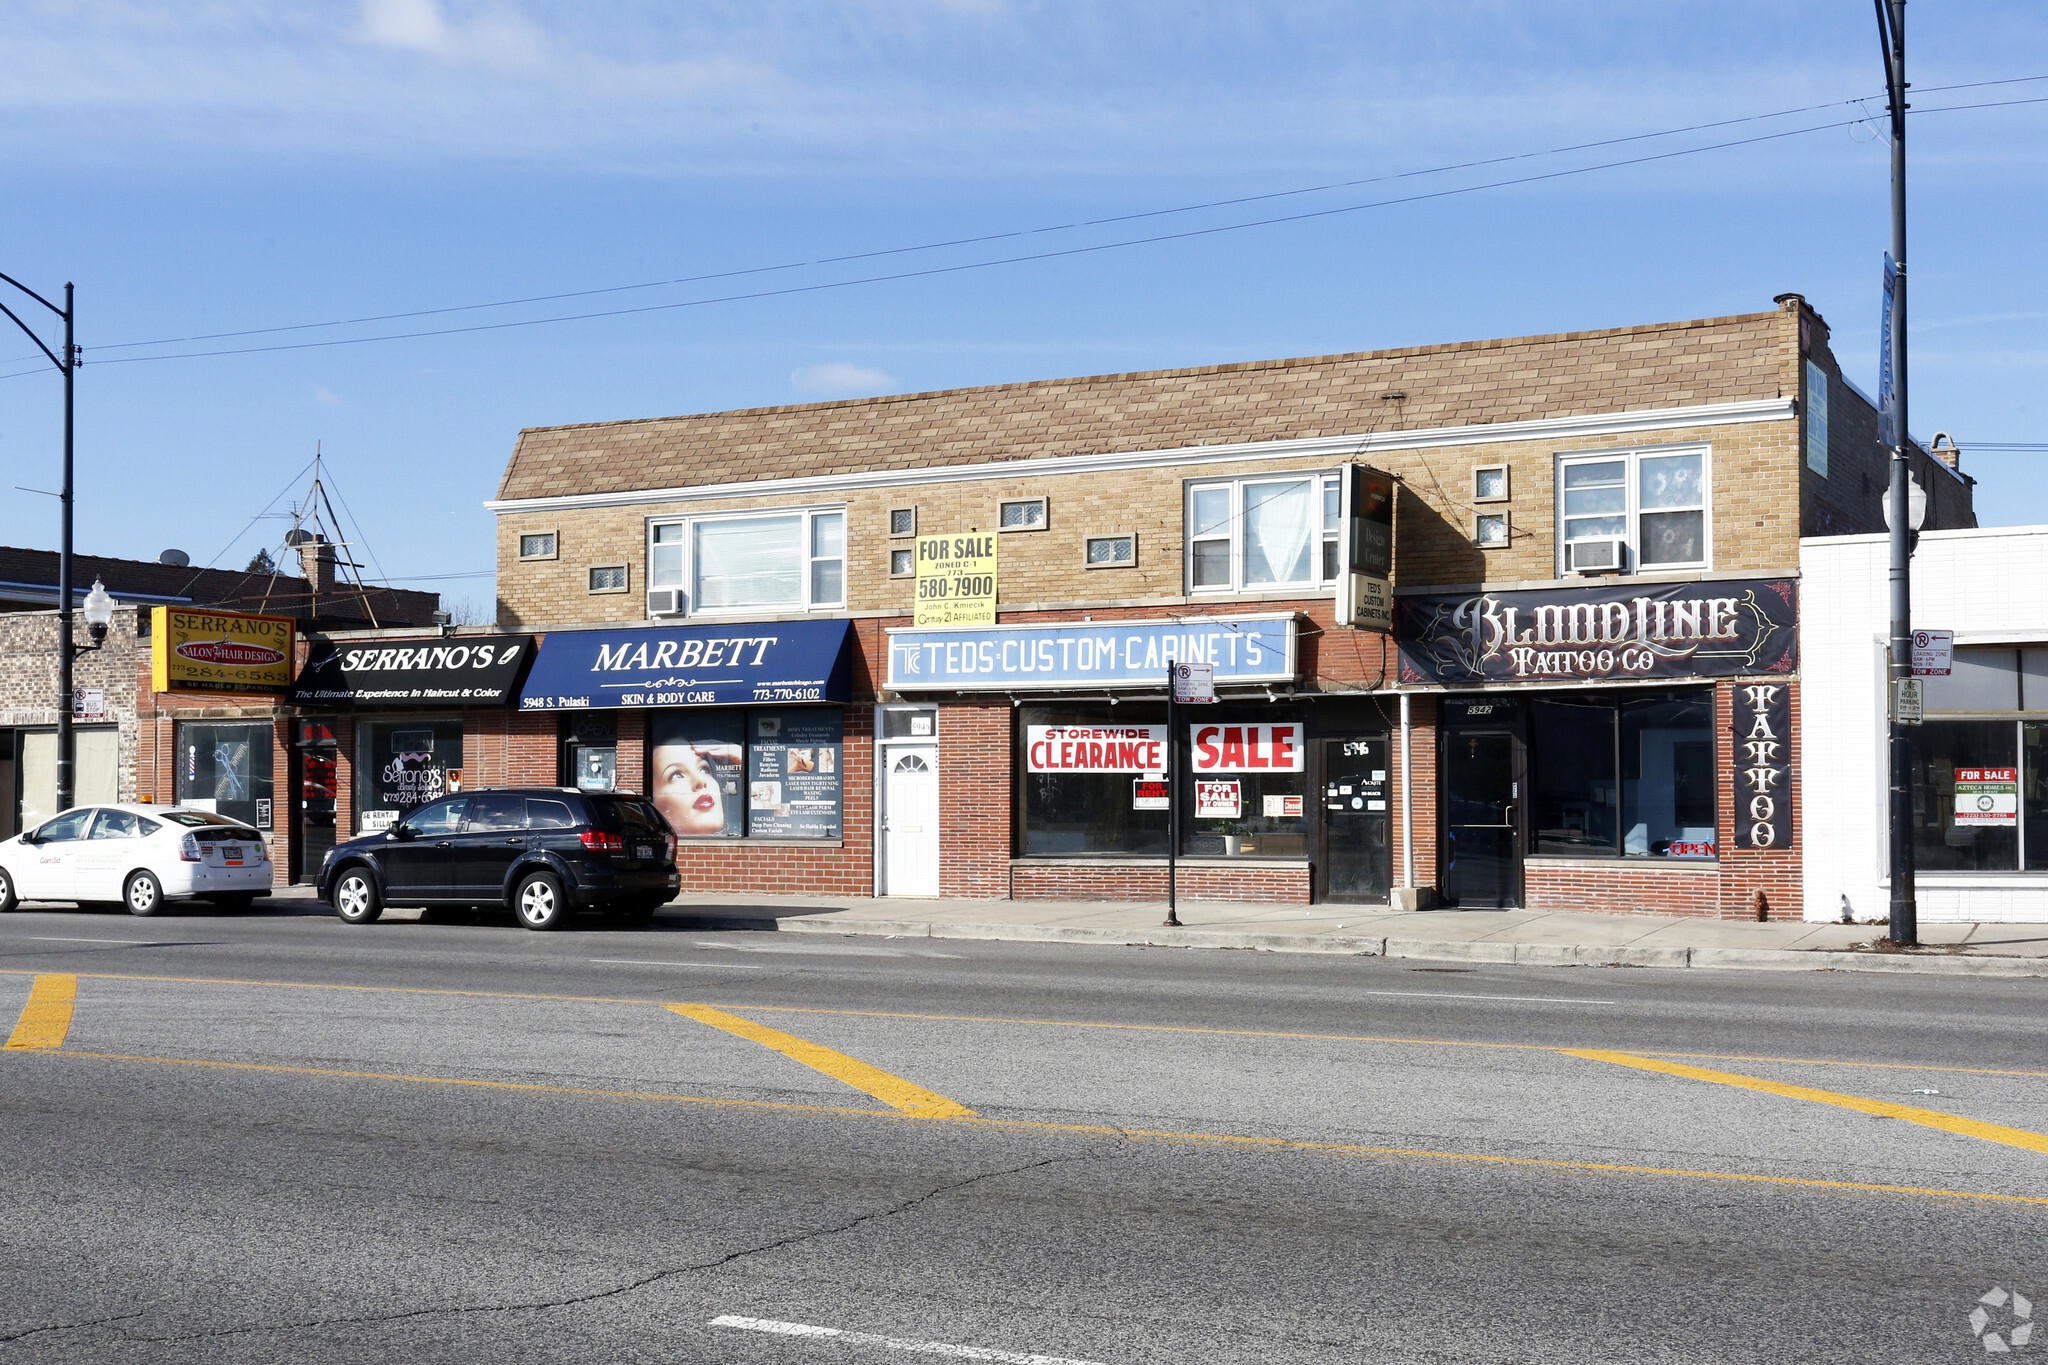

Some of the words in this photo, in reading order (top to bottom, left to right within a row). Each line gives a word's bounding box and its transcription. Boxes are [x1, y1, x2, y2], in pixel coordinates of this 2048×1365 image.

[1365, 527, 1385, 549] Design
[920, 540, 949, 560] FOR
[954, 537, 993, 558] SALE
[935, 561, 961, 569] ZONED
[1365, 550, 1385, 567] Center
[919, 576, 993, 598] 580-7900
[1367, 582, 1381, 594] TED'S
[944, 601, 952, 609] C.
[954, 600, 985, 609] Kmiecik
[1363, 594, 1384, 606] CUSTOM
[918, 613, 942, 625] Century
[943, 611, 952, 623] 21
[953, 611, 992, 622] AFFILIATED
[1357, 606, 1381, 619] CABINETS
[1381, 609, 1391, 620] INC.
[174, 614, 288, 637] SERRANO'S
[182, 646, 213, 657] SALON
[221, 649, 243, 659] HAIR
[244, 651, 278, 662] DESIGN
[341, 645, 495, 672] SERRANO'S
[591, 636, 777, 672] MARBETT
[1002, 637, 1117, 673] CUSTOM
[1125, 631, 1263, 670] CABINETS
[186, 666, 288, 682] 284-6583
[202, 682, 232, 690] HABLA
[295, 690, 313, 698] The
[314, 690, 354, 698] Ultimate
[355, 689, 410, 699] Experience
[423, 688, 460, 698] Haircut
[461, 688, 472, 697] &
[473, 688, 502, 697] Color
[621, 693, 645, 705] SKIN
[646, 693, 655, 704] &
[657, 692, 686, 704] BODY
[687, 691, 715, 703] CARE
[752, 688, 820, 700] 773-770-6102
[523, 697, 544, 708] 5948
[546, 697, 555, 707] S.
[558, 696, 590, 707] Pulaski
[1468, 706, 1492, 714] 5942
[1045, 729, 1150, 740] STOREWIDE
[1196, 726, 1294, 768] SALE
[1343, 741, 1369, 756] 5946
[1031, 741, 1161, 769] CLEARANCE
[1742, 684, 1782, 848] TATTOO
[383, 764, 442, 788] Serrano's
[1961, 770, 1980, 780] FOR
[1984, 770, 2010, 780] SALE
[1204, 784, 1231, 793] FOR
[1200, 792, 1238, 801] SALE
[1284, 801, 1301, 810] Closed
[363, 811, 371, 819] SE
[373, 811, 394, 819] RENTA
[1670, 842, 1716, 856] OPEN
